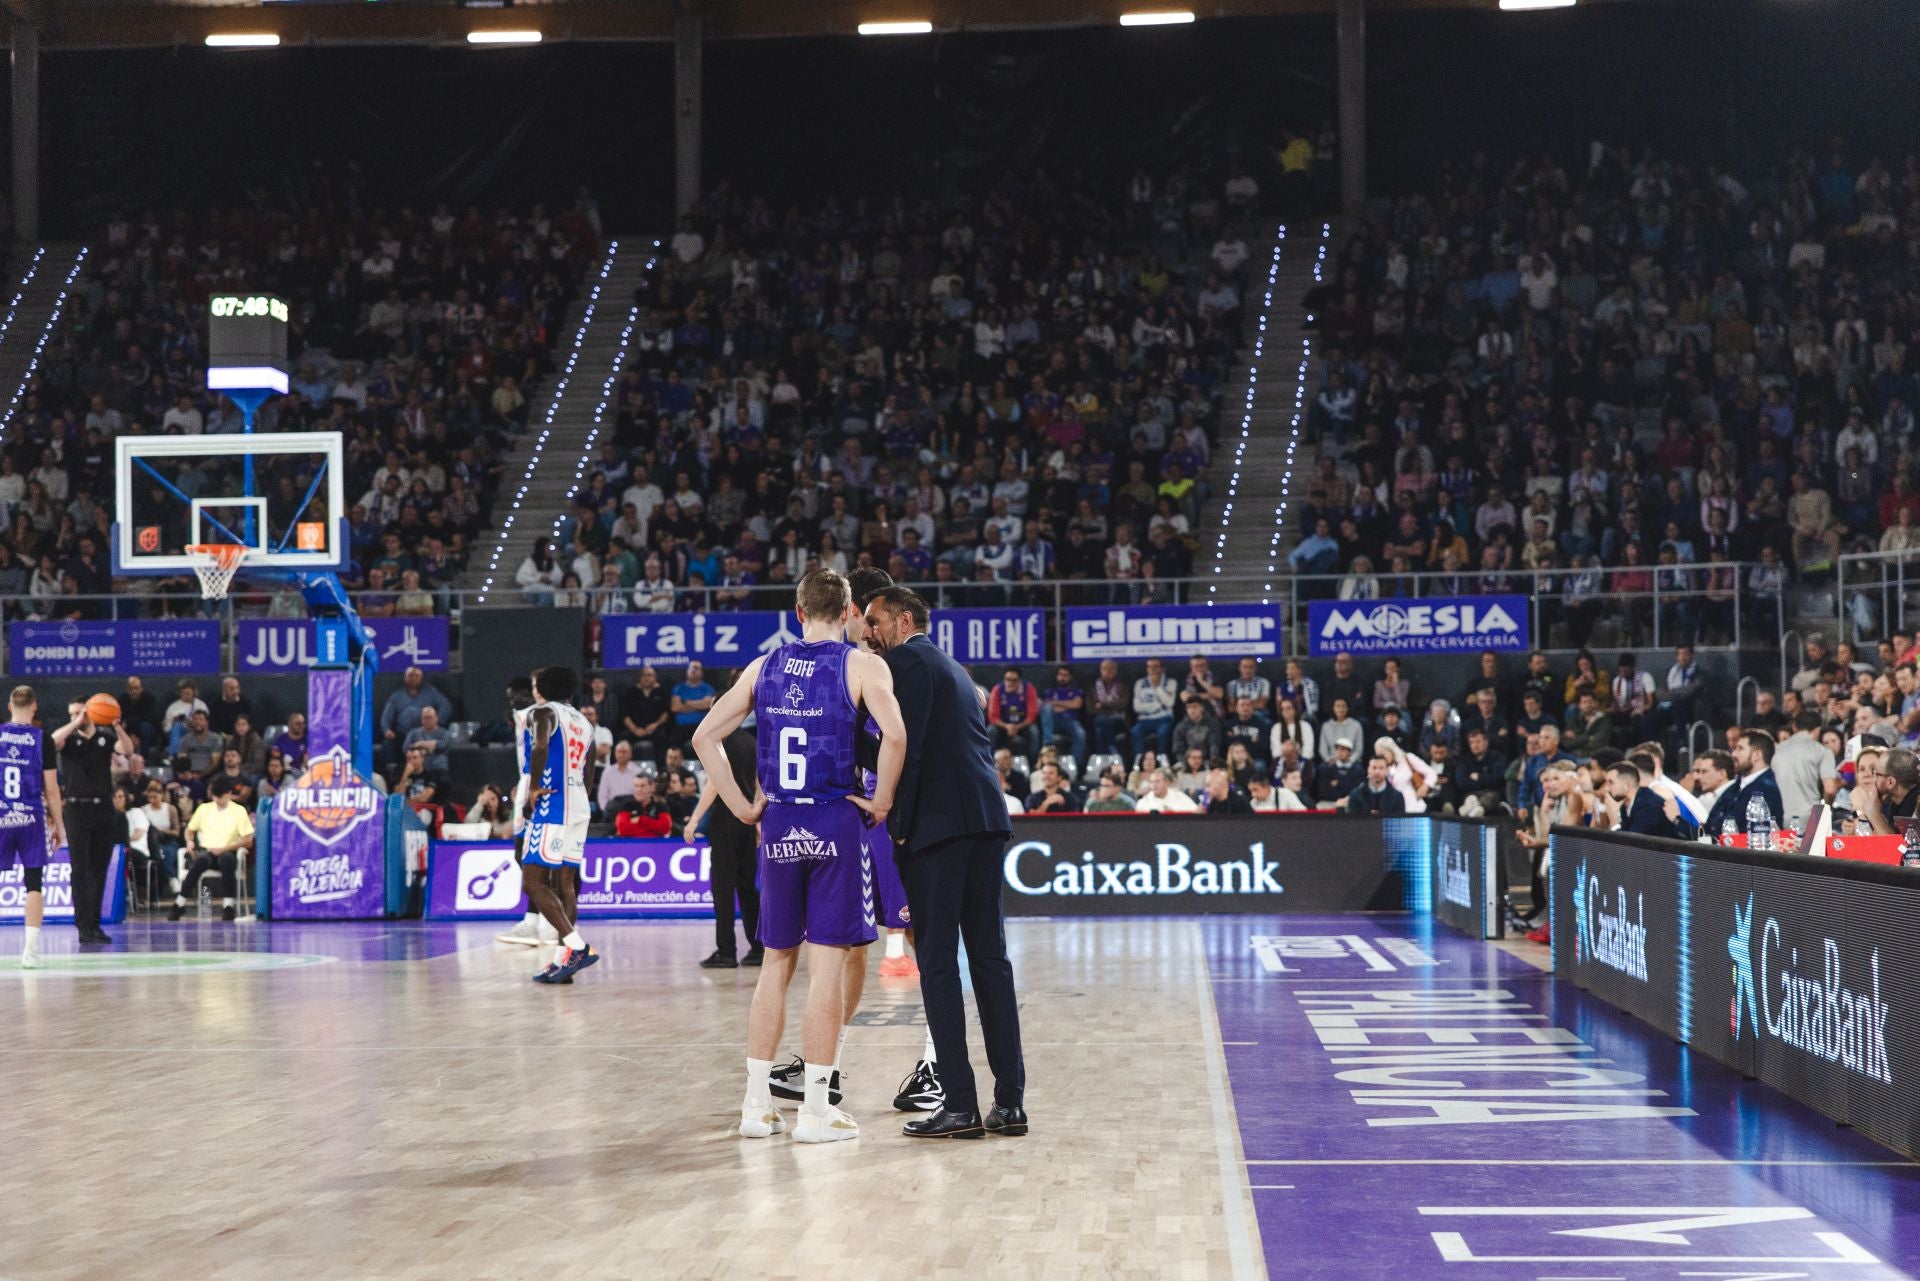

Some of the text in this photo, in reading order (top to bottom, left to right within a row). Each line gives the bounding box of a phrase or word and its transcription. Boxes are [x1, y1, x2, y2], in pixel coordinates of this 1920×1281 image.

[968, 613, 1040, 659] RENÉ
[1071, 610, 1275, 645] clomar
[1321, 603, 1519, 639] MOESIA
[246, 627, 319, 666] JUL
[802, 706, 823, 717] salud
[779, 726, 808, 791] 6
[4, 766, 21, 799] 8
[286, 786, 371, 811] PALENCIA
[765, 840, 838, 859] LEBANZA
[289, 869, 364, 897] PALENCIA
[580, 856, 656, 892] upo
[1003, 840, 1285, 896] CaixaBank
[578, 891, 613, 904] uridad
[615, 893, 623, 905] y
[685, 890, 701, 903] de
[1761, 917, 1893, 1085] CaixaBank
[1293, 990, 1700, 1128] PALENCIA
